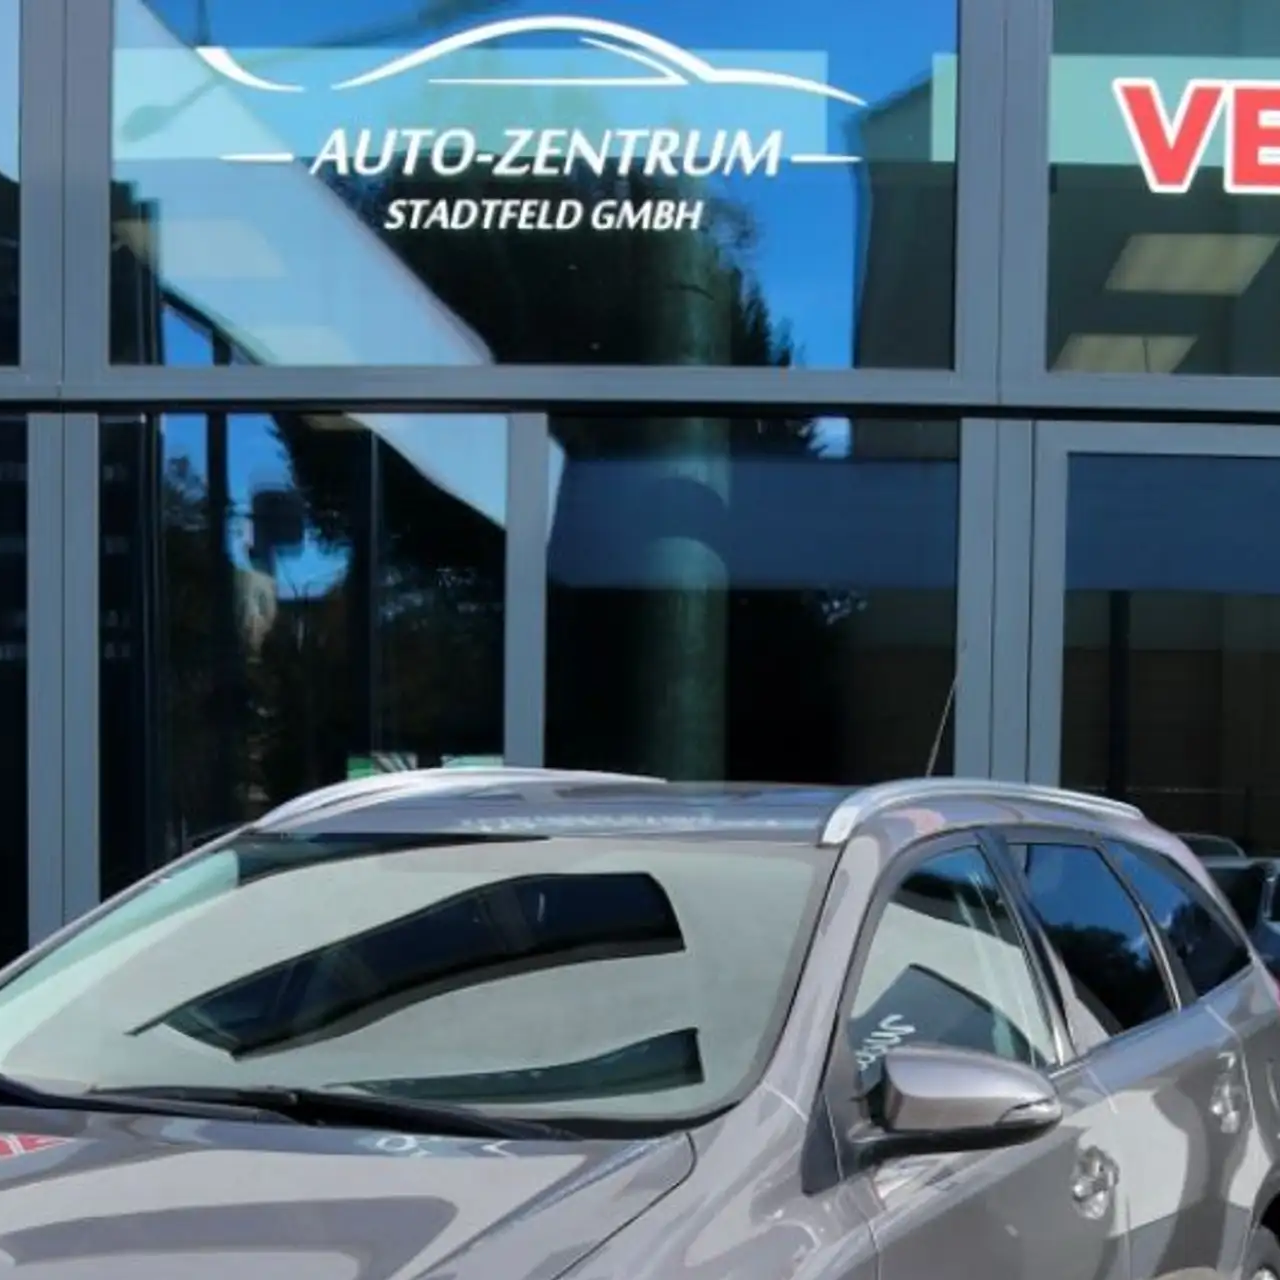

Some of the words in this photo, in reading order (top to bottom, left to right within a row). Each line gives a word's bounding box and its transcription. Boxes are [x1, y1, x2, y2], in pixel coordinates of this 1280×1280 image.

[310, 127, 783, 178] AUTO-ZENTRUM
[384, 199, 581, 232] STADTFELD
[590, 199, 704, 232] GMBH
